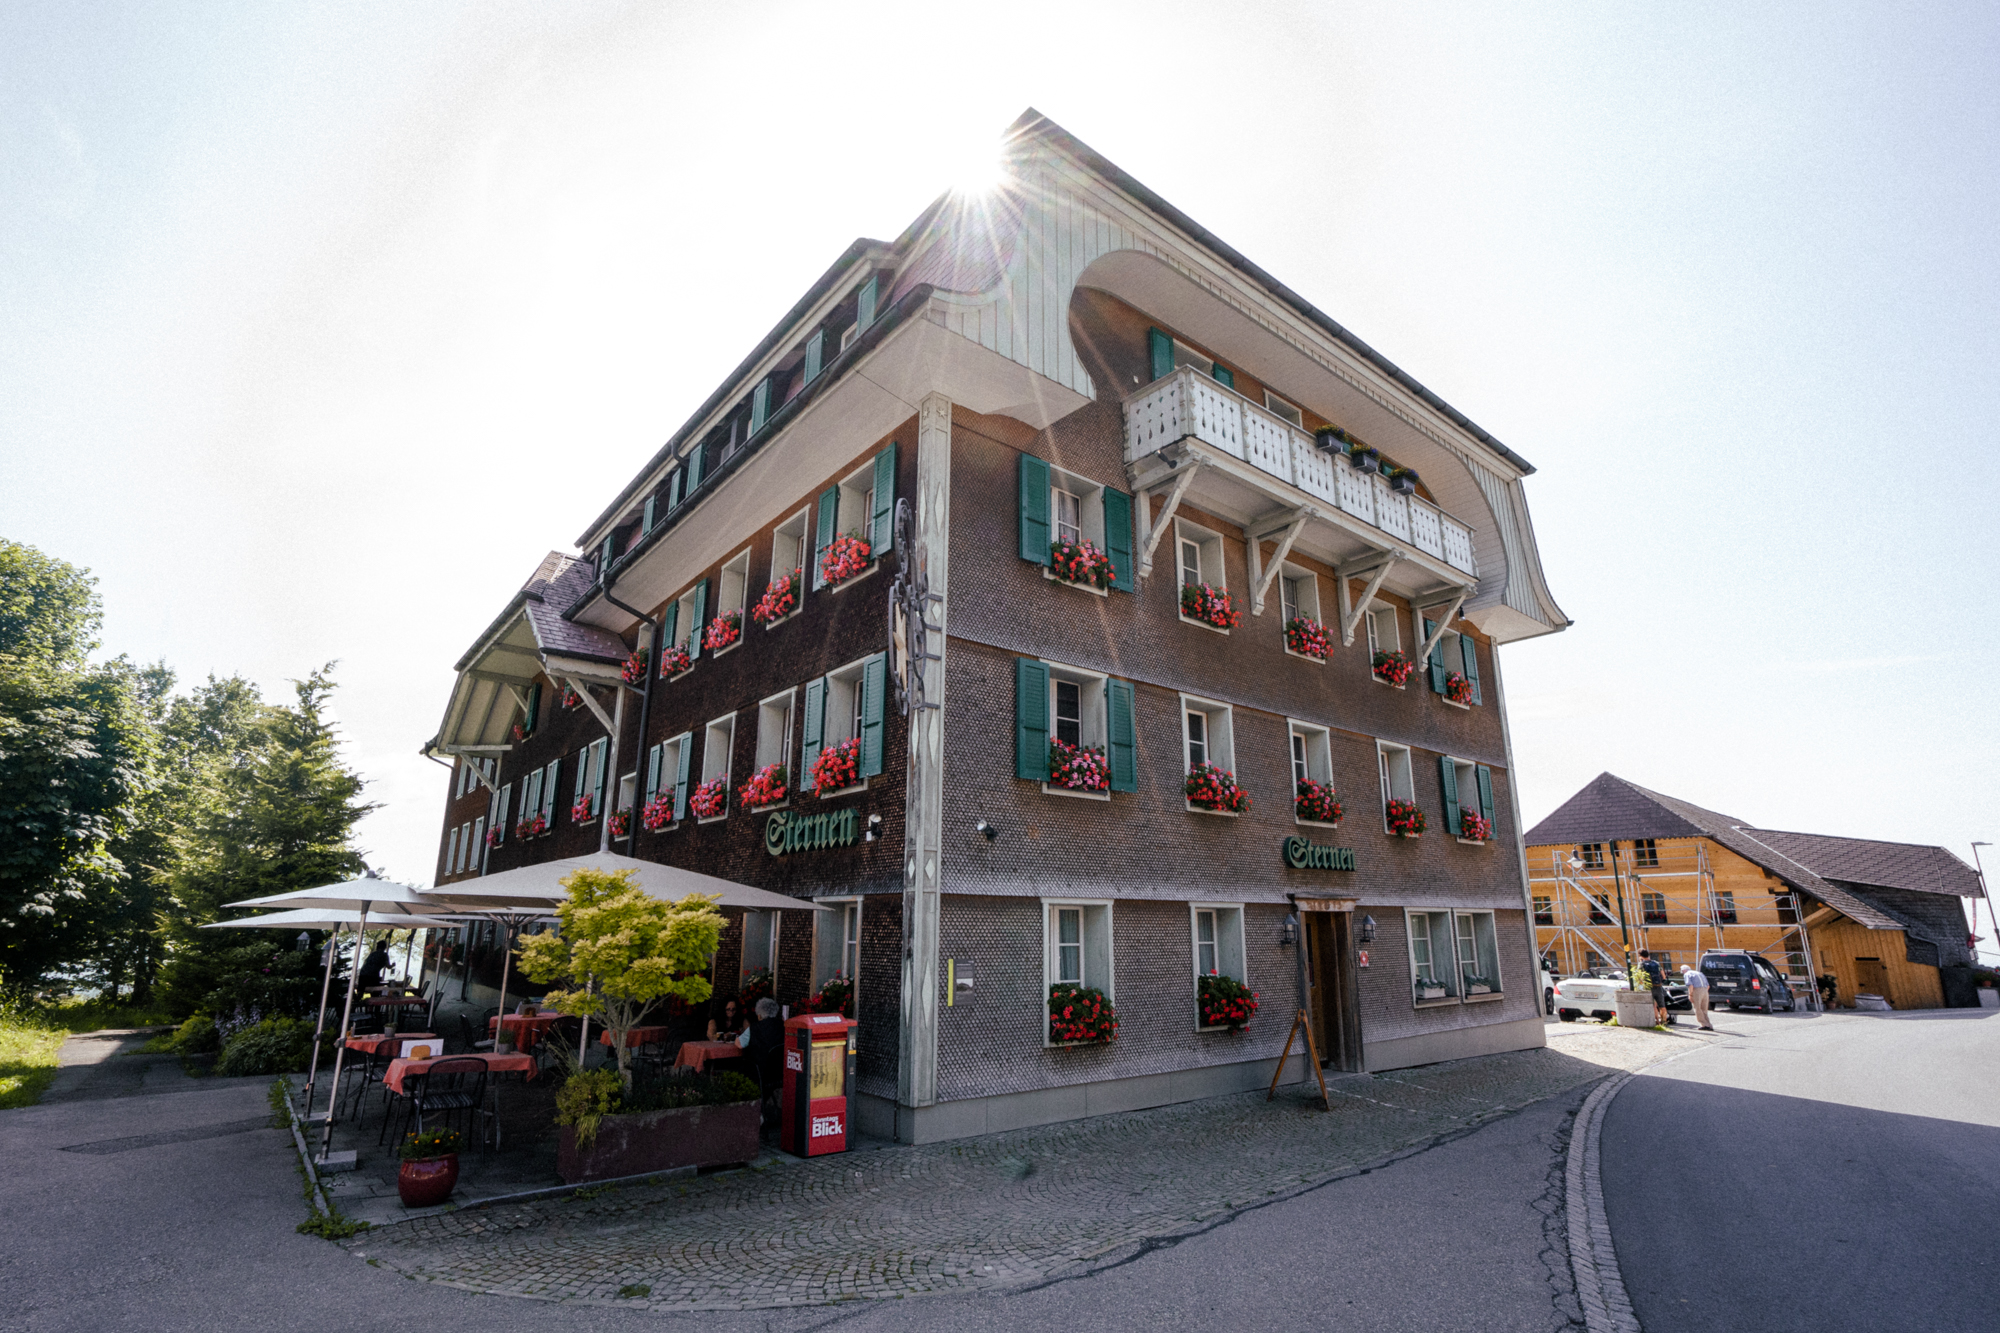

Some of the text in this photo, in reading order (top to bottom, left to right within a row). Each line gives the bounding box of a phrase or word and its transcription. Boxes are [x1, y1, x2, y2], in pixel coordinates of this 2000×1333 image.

[766, 808, 858, 856] Sternen
[1286, 836, 1357, 871] Sternen
[787, 1056, 803, 1071] Blick
[812, 1116, 839, 1124] Sonntags
[812, 1120, 843, 1138] Blick
